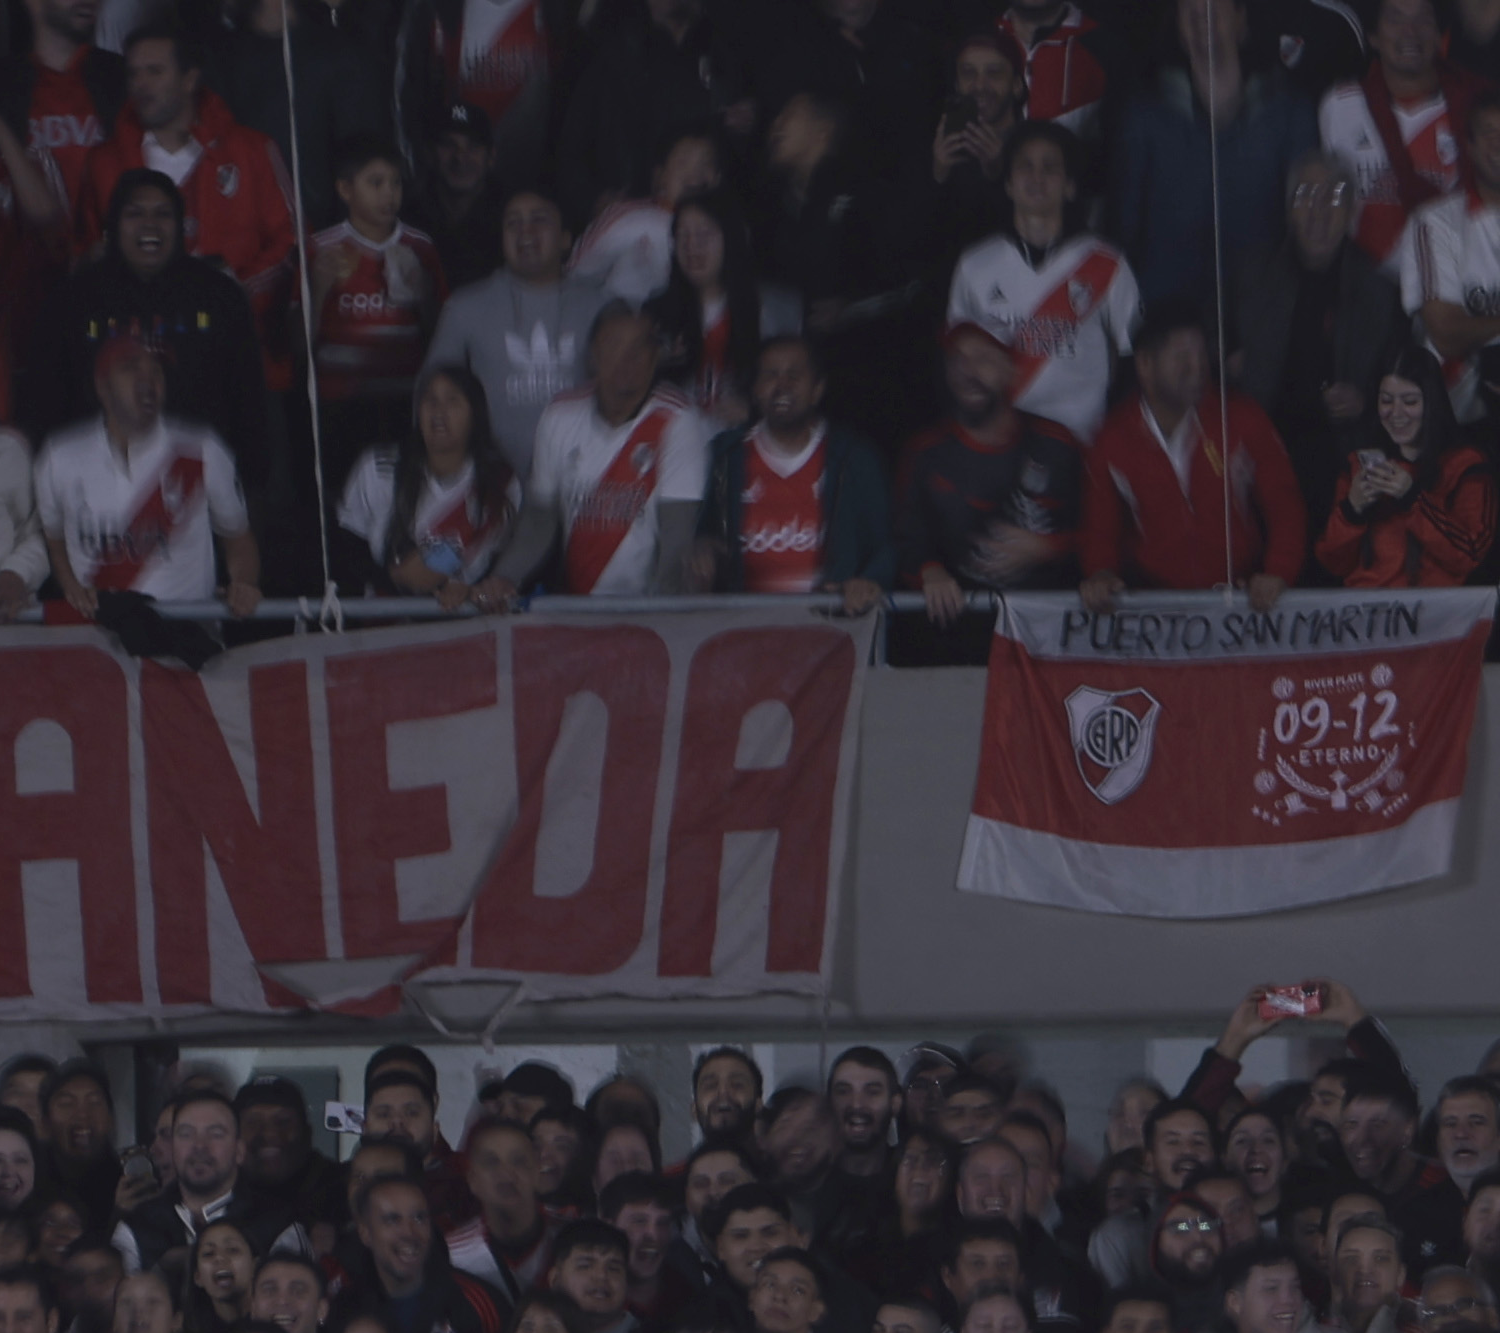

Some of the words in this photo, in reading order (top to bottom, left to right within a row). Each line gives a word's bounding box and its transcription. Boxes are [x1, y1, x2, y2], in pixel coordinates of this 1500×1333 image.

[1059, 609, 1211, 656] PUERTO
[1220, 611, 1283, 650] SAN
[1304, 676, 1335, 690] RIVER
[1335, 672, 1365, 687] PLATE
[1273, 688, 1400, 747] 09-12
[1299, 746, 1379, 767] ETERNO
